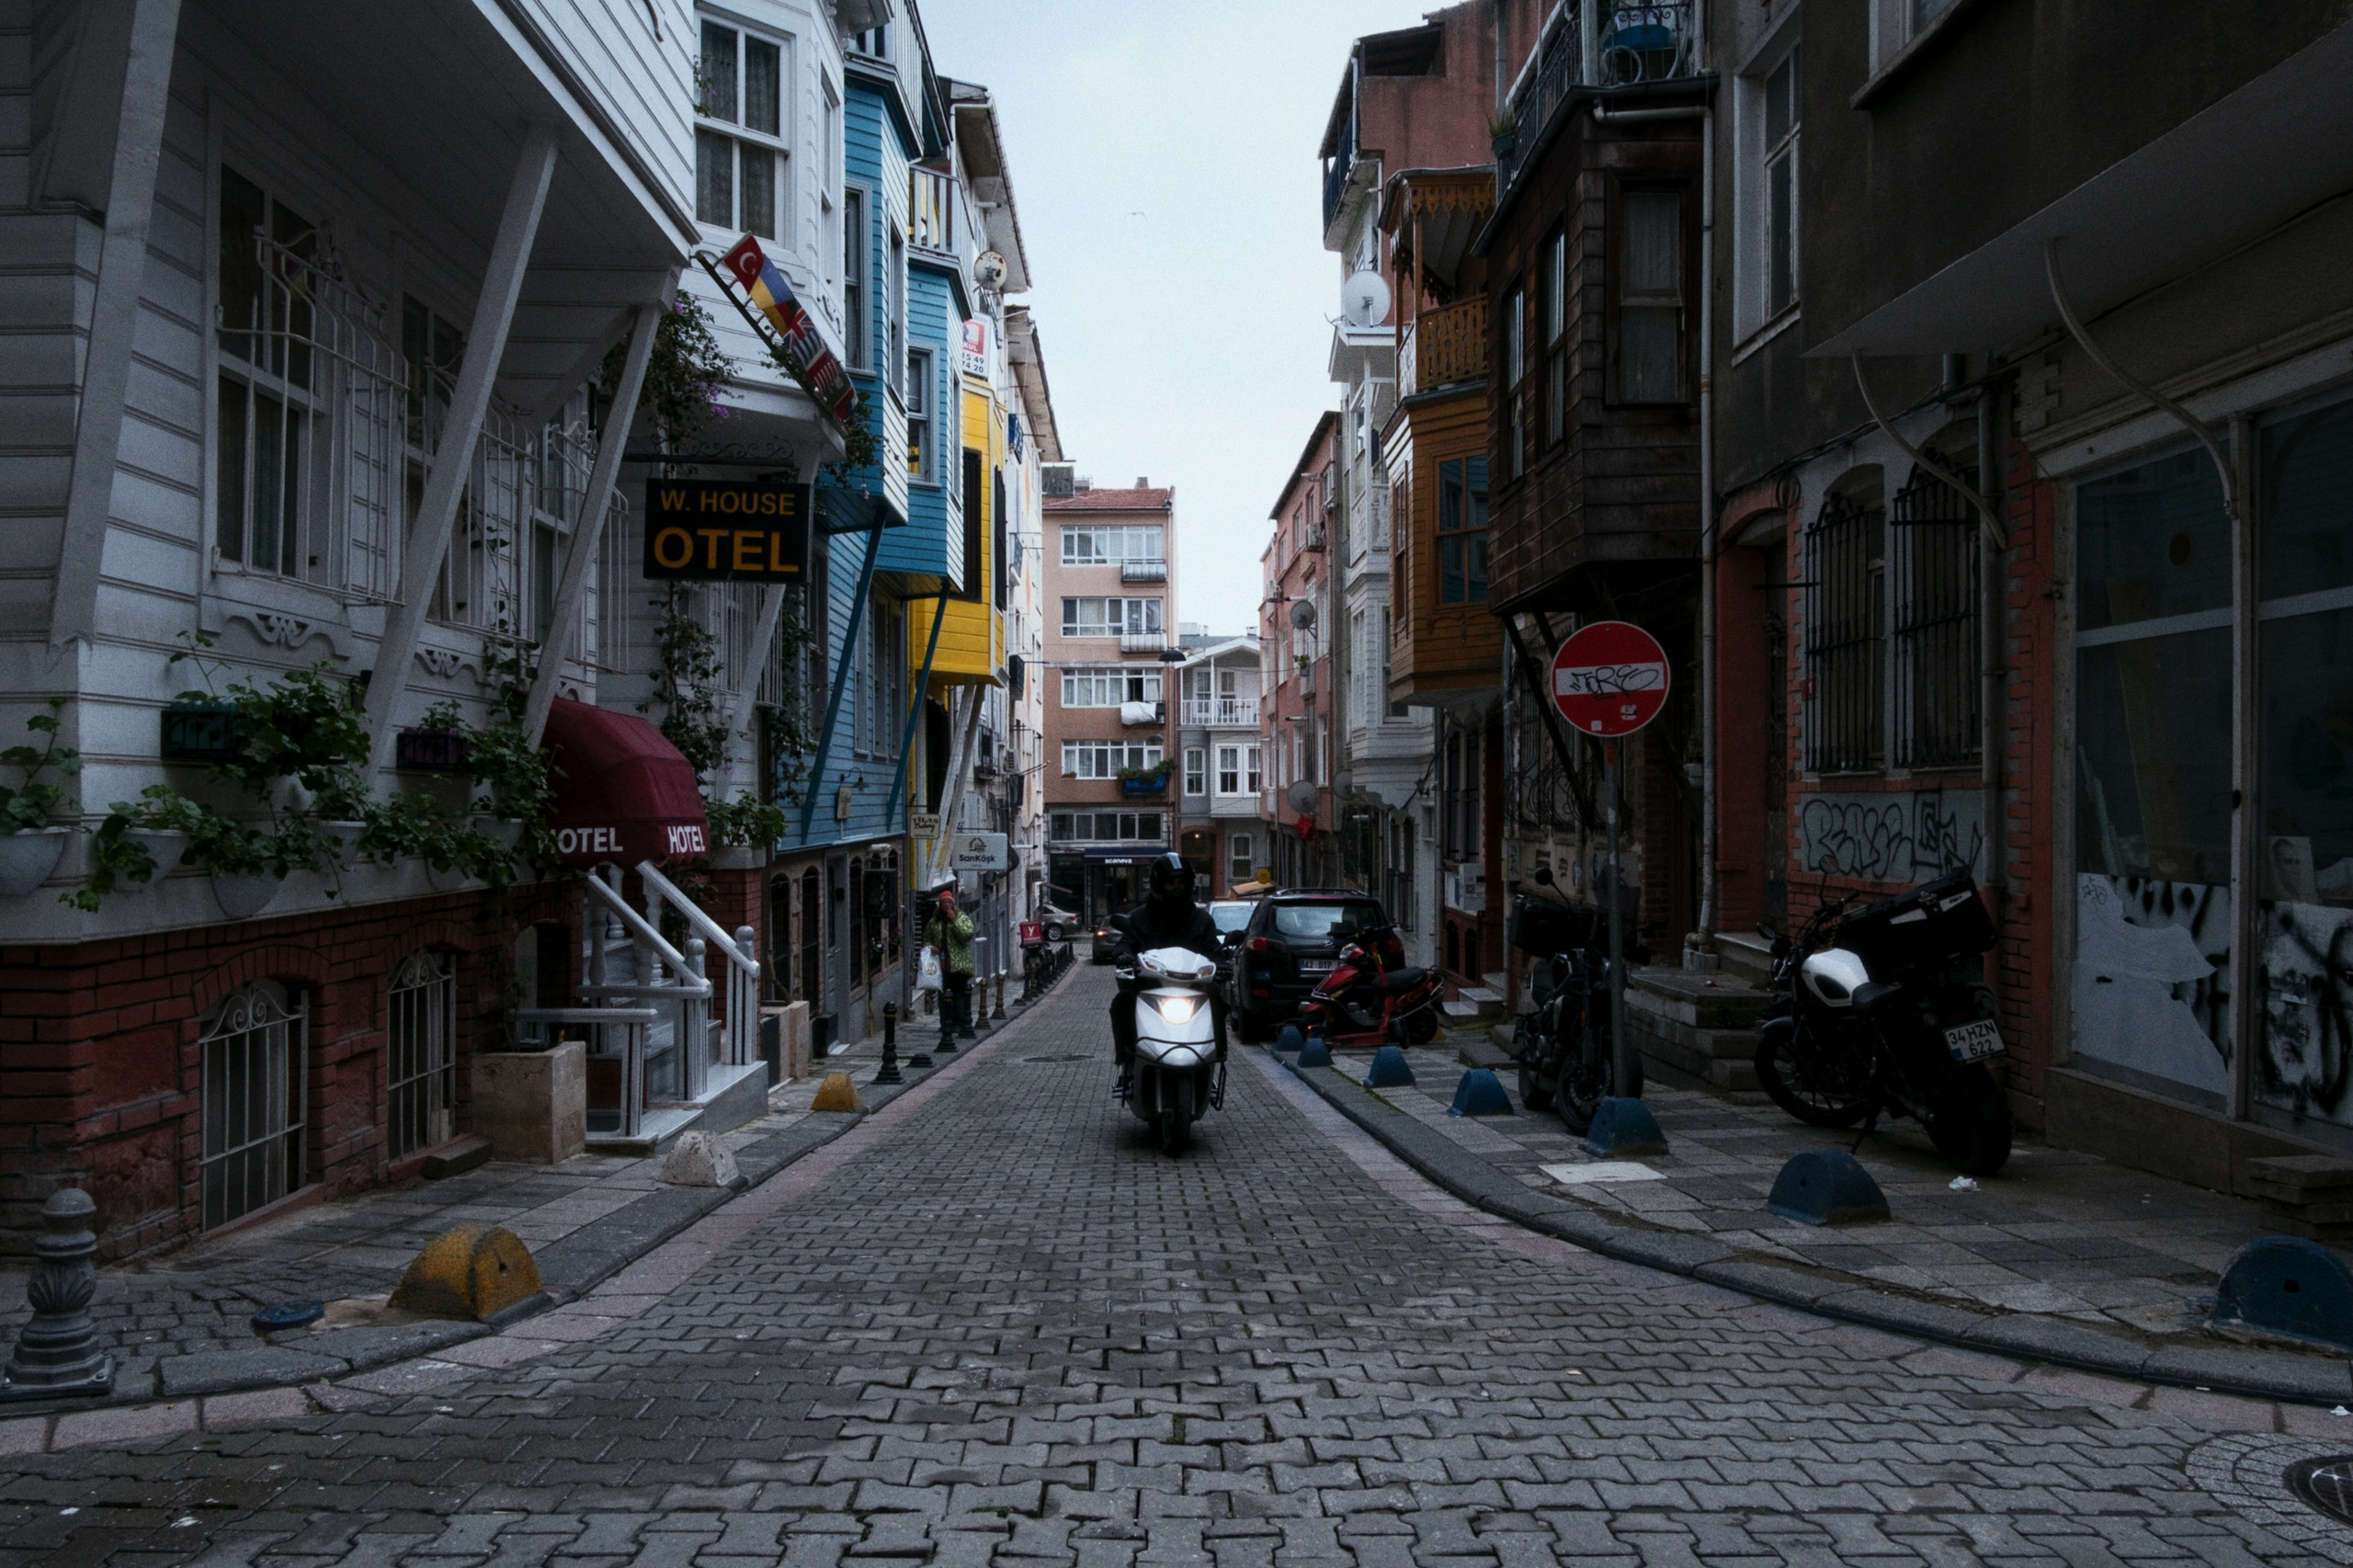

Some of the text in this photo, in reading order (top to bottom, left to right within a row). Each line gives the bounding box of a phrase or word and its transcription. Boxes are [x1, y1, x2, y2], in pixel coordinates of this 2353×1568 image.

[974, 357, 984, 365] 49
[974, 364, 984, 373] 20
[660, 489, 796, 516] W. HOUSE
[654, 526, 801, 573] OTEL
[538, 827, 624, 854] OTEL
[667, 825, 706, 854] HOTEL
[959, 854, 995, 864] SanKöşk
[1949, 1021, 1996, 1045] 34 HZN
[1969, 1039, 1995, 1056] 622
